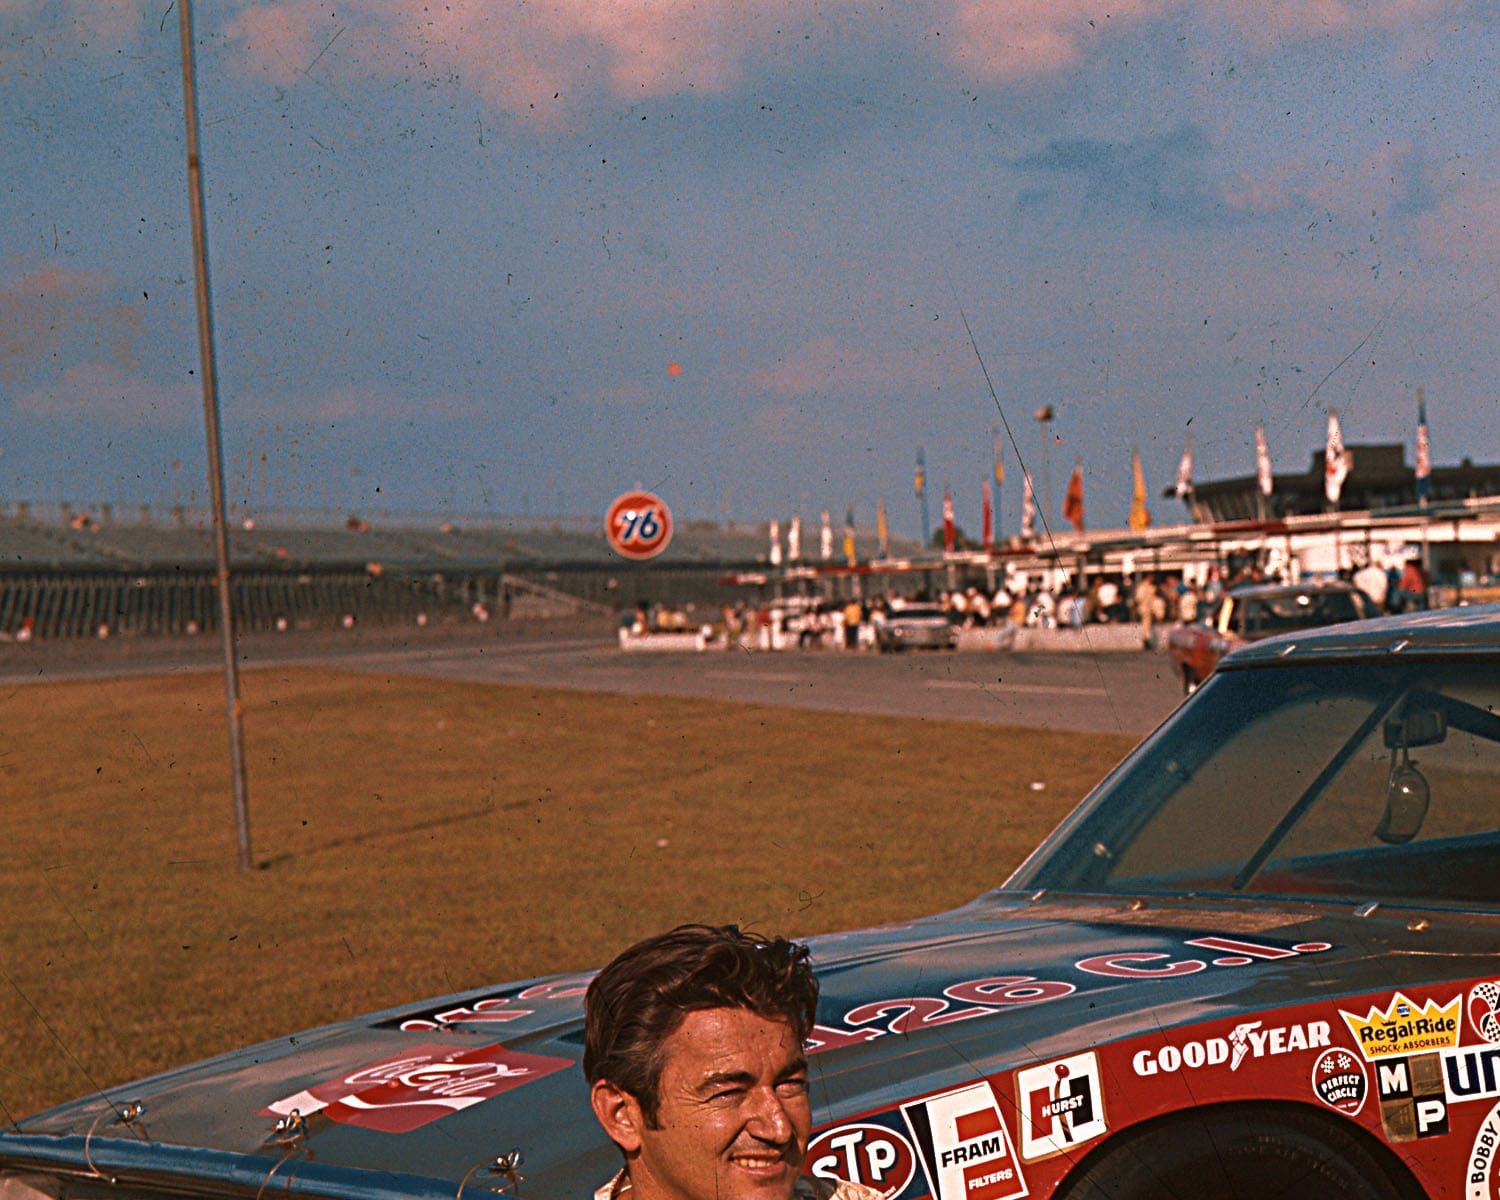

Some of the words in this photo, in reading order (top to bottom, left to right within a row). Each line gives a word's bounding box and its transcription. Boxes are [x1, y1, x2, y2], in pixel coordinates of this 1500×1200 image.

[619, 507, 661, 542] 76
[1370, 1045, 1400, 1055] SHOCK
[1403, 1037, 1451, 1051] ABSORBERS
[1320, 1074, 1360, 1094] PERFECT
[1327, 1086, 1358, 1102] CIRCLE
[1041, 1095, 1084, 1117] HURST
[811, 1130, 896, 1185] STP
[941, 1137, 1001, 1168] FRAM
[1471, 1121, 1499, 1184] BOBBY
[968, 1168, 1014, 1191] FILTERS
